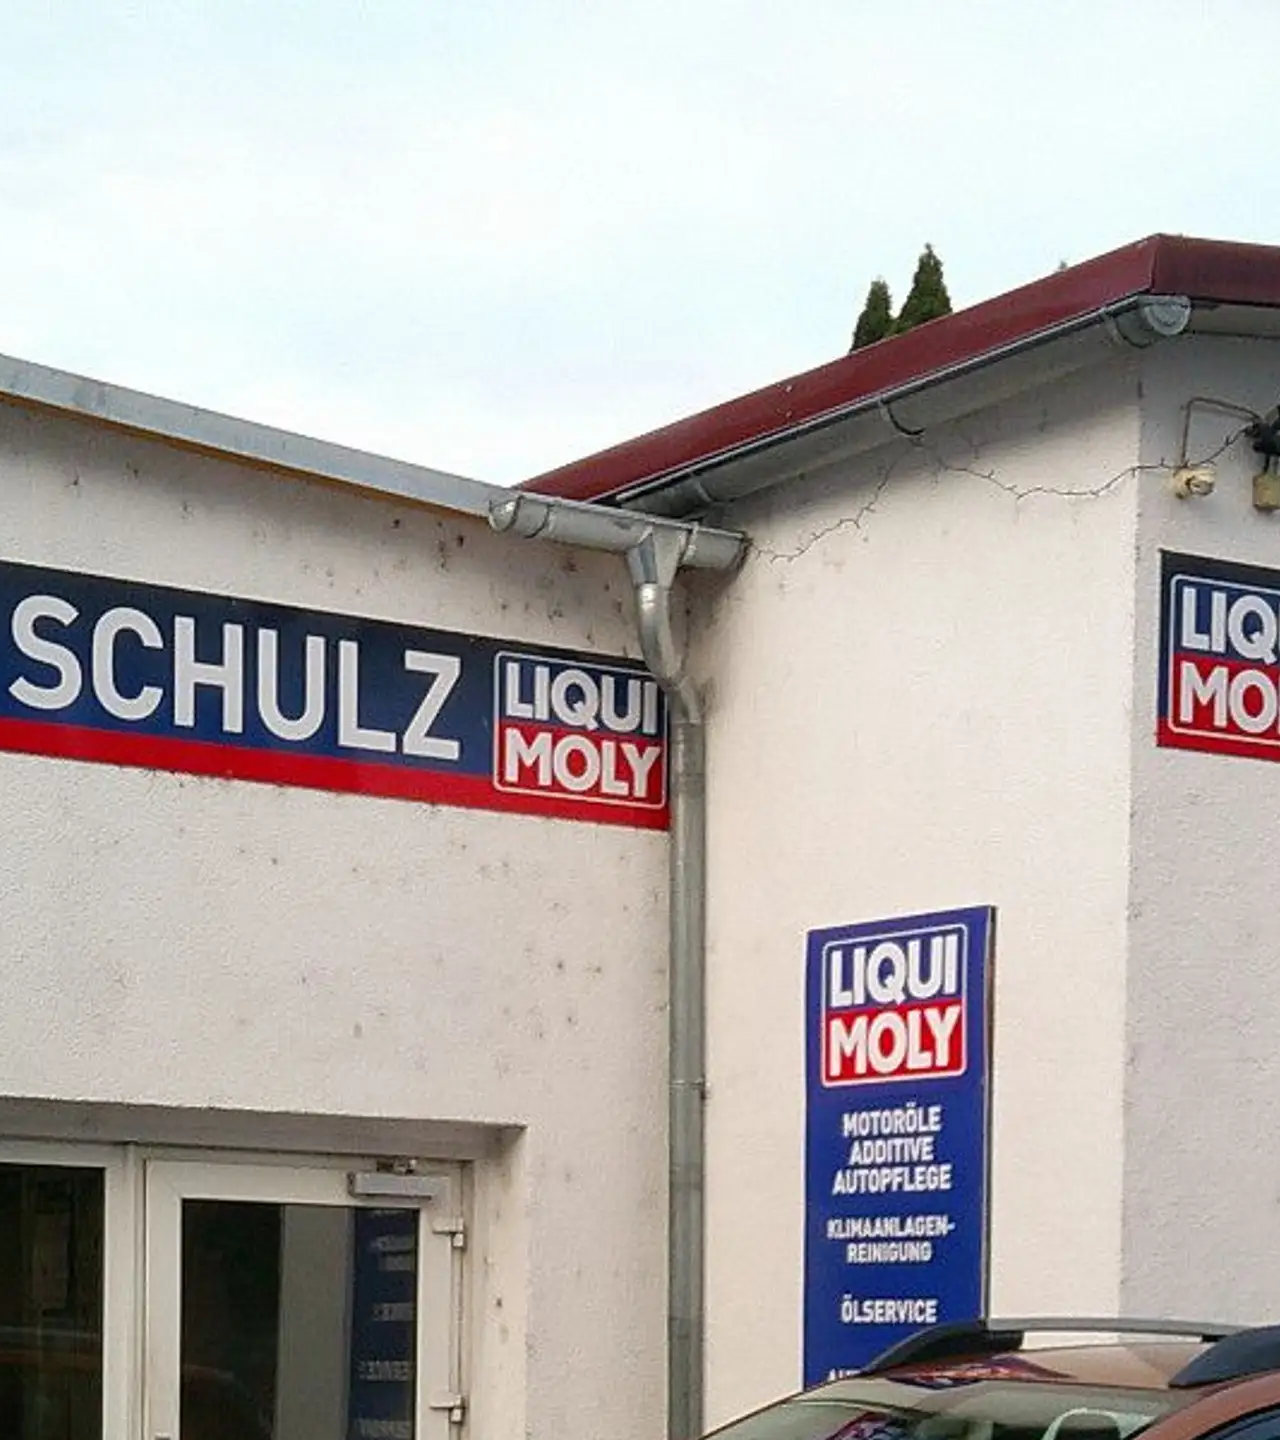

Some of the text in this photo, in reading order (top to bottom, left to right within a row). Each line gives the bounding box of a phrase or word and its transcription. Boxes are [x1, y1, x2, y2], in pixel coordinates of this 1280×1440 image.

[8, 594, 462, 761] SCHULZ
[505, 662, 658, 735] LIQUI
[504, 730, 661, 798] MOLY
[830, 933, 959, 1007] LIQUI
[829, 1004, 961, 1077] MOLY
[843, 1101, 942, 1136] MOTORÖLE
[849, 1136, 934, 1166] ADDITIVE
[831, 1164, 952, 1195] AUTOPFLEGE
[827, 1214, 956, 1240] KLIMAANLAGEN-
[846, 1242, 932, 1264] REINIGUNG
[841, 1293, 938, 1324] ÖLSERVICE
